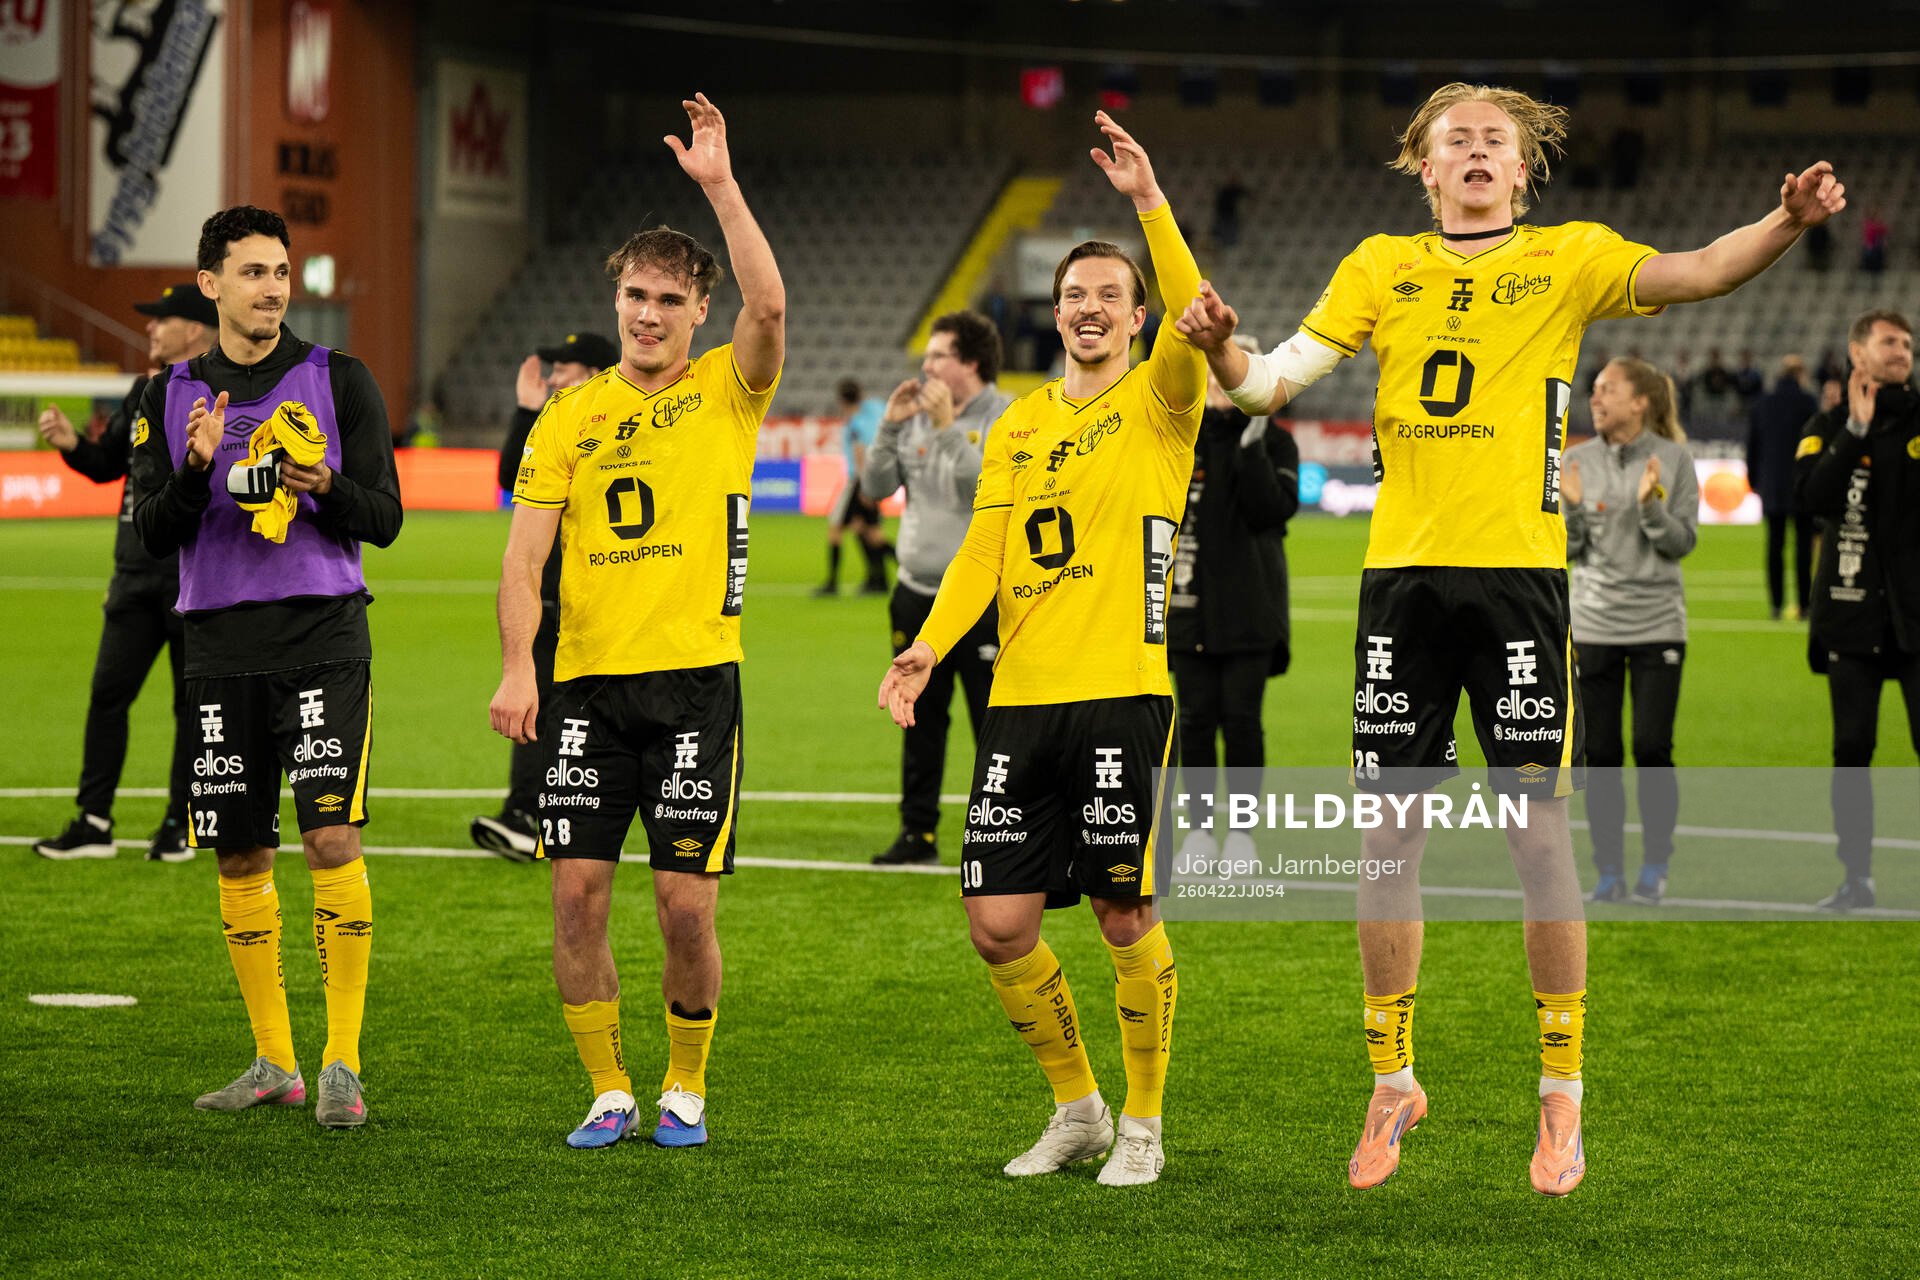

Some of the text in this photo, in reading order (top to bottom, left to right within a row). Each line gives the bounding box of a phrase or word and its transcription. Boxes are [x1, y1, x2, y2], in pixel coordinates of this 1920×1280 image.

[1491, 272, 1552, 305] Elfsborg
[651, 391, 703, 429] Elfsborg
[1076, 411, 1123, 457] Elfsborg
[599, 461, 638, 471] TOVEKS
[1355, 683, 1410, 714] ellos
[1496, 689, 1556, 720] ellos
[1358, 719, 1416, 735] Skrotfrag
[1504, 726, 1563, 743] Skrotfrag
[294, 733, 343, 763] ellos
[193, 749, 244, 776] ellos
[297, 764, 348, 781] Skrotfrag
[545, 758, 599, 788] ellos
[1355, 749, 1380, 780] 26
[661, 771, 713, 800] ellos
[547, 793, 600, 809] Skrotfrag
[664, 806, 718, 823] Skrotfrag
[969, 798, 1023, 826] ellos
[1083, 797, 1136, 825] ellos
[195, 811, 218, 837] 22
[543, 818, 571, 846] 28
[971, 829, 1028, 844] Skrotfrag
[1091, 831, 1140, 846] Skrotfrag
[675, 850, 700, 858] umbro
[963, 860, 983, 889] 10
[1112, 875, 1136, 883] umbro
[1544, 1011, 1571, 1025] 26
